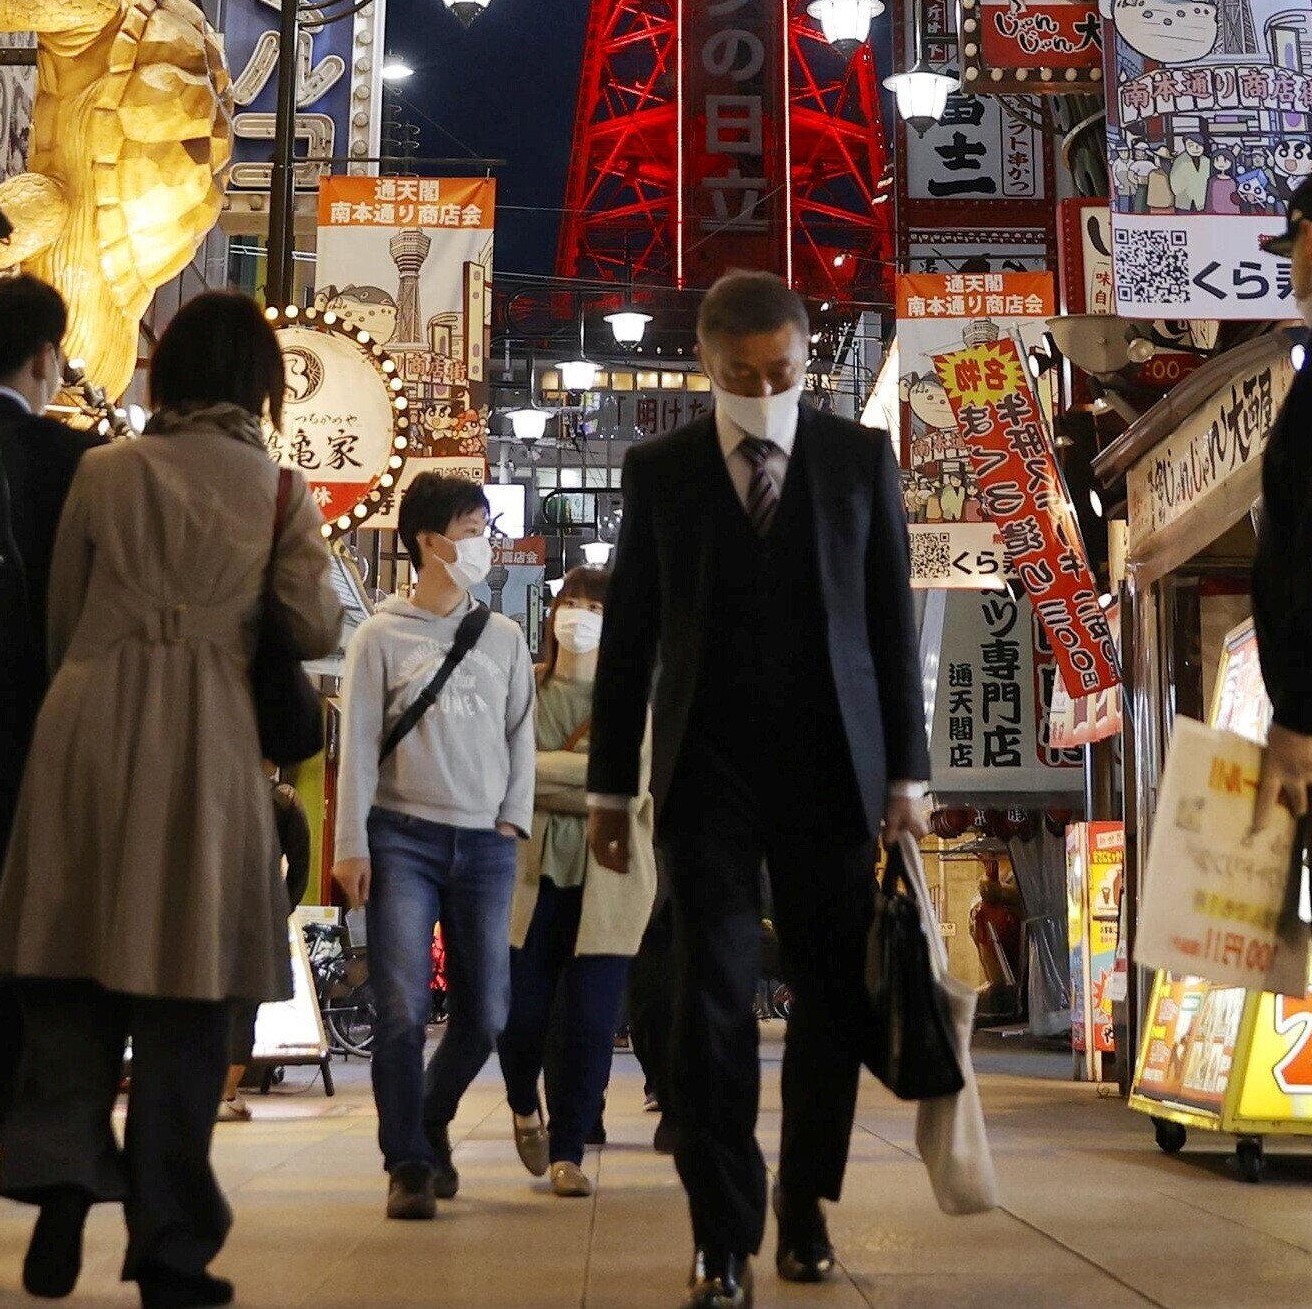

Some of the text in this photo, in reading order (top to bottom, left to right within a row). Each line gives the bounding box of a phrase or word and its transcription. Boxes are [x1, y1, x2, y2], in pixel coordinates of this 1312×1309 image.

[374, 179, 441, 203] 通天閣
[329, 201, 484, 227] 南本通り商店会
[944, 274, 1004, 293] 通天閣
[1094, 271, 1112, 315] 味自
[907, 293, 1044, 317] 南本通り商店会
[948, 662, 975, 768] 通天閣店
